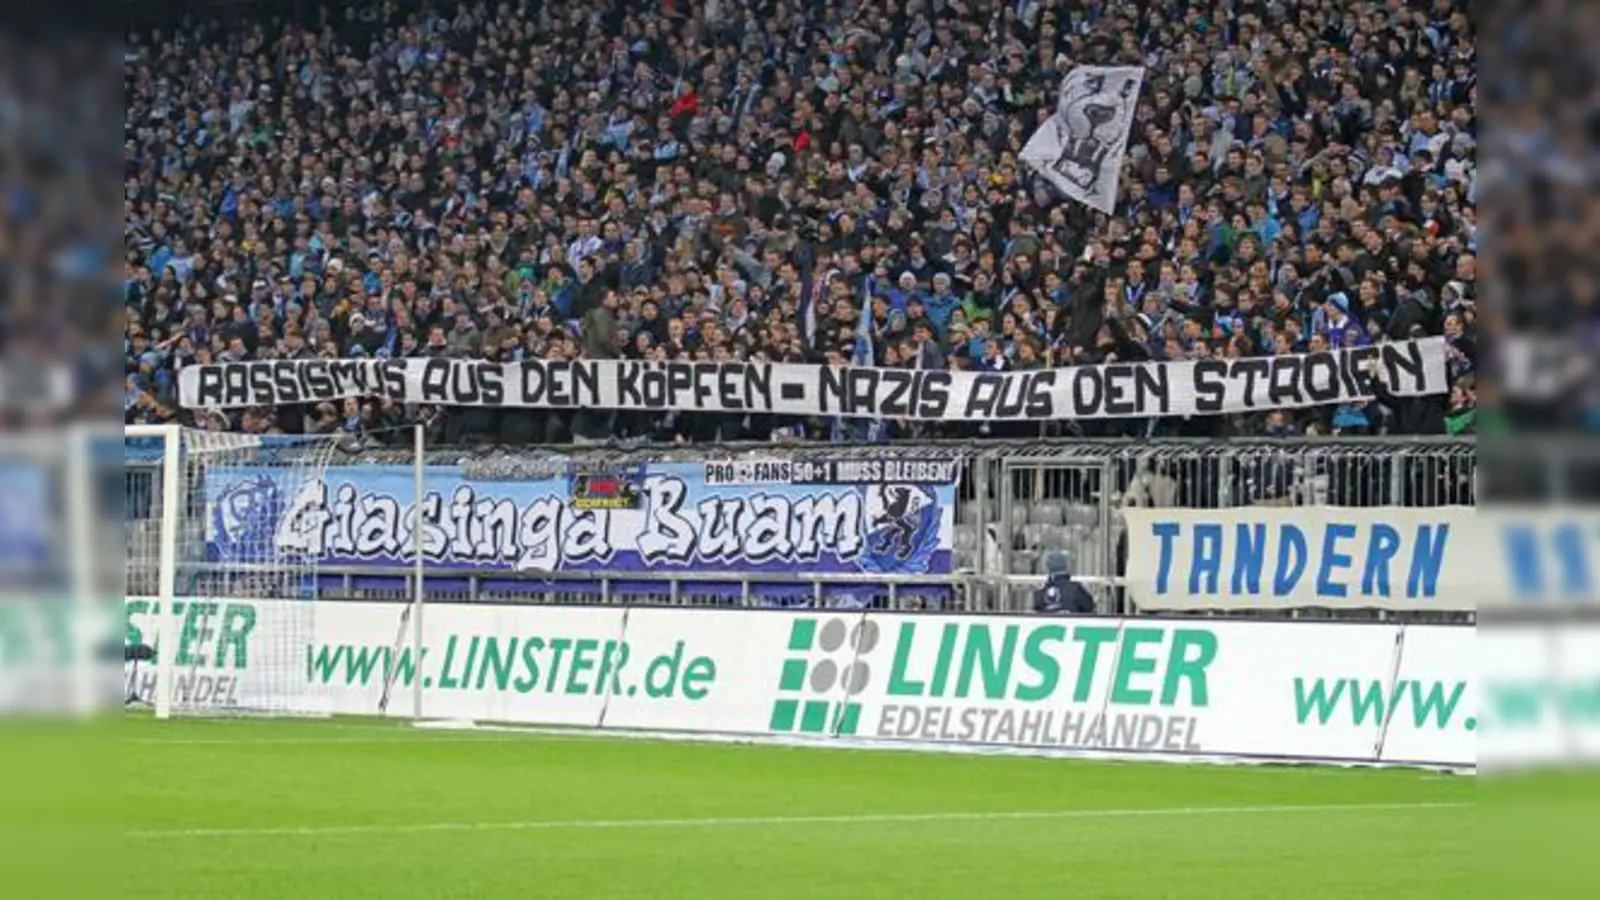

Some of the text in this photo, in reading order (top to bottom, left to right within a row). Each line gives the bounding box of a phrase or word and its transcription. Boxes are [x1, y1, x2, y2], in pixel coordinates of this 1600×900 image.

[198, 358, 406, 405] RASSISMUS
[422, 358, 504, 403] AUS
[522, 361, 599, 405] DEN
[819, 366, 952, 417] NAZIS
[964, 371, 1056, 418] AUS
[1073, 365, 1168, 415] DEN
[705, 463, 789, 482] PRO FANS
[791, 463, 830, 481] 50+1
[275, 475, 863, 571] Giasinga Buam
[1151, 522, 1450, 599] TANDERN
[306, 634, 717, 700] www.LINSTER.de
[886, 621, 1218, 707] LINSTER
[876, 703, 1201, 750] EDELSTAHLHANDEL
